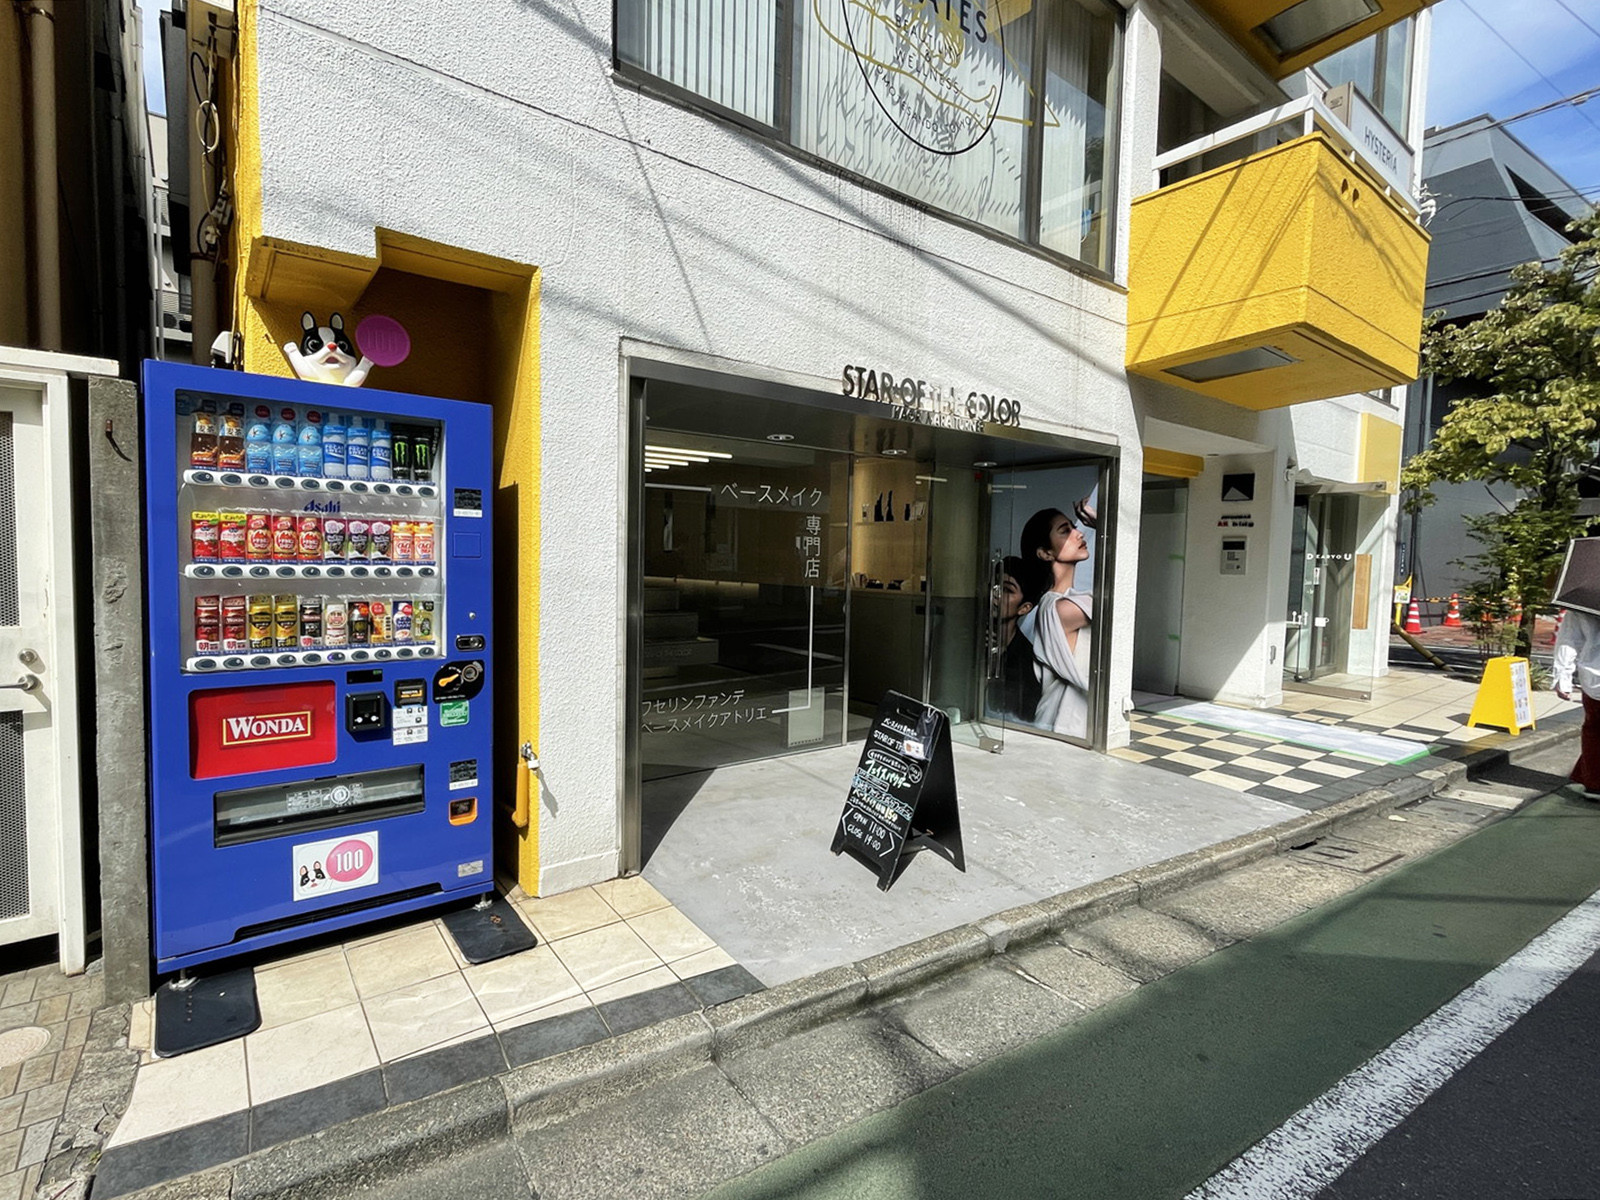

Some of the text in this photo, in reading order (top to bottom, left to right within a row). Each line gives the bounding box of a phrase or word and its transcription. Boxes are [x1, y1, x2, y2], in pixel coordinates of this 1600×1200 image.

[1364, 126, 1398, 175] HYSTERIA
[842, 364, 894, 404] STAR
[900, 377, 926, 408] OF
[966, 391, 1022, 427] COLOR
[303, 499, 341, 513] Asahi
[720, 481, 822, 507] ベースメイク
[804, 515, 821, 578] 専門店
[227, 715, 305, 740] WONDA
[641, 707, 767, 735] ベースメイクアトリエ
[335, 848, 365, 873] 100
